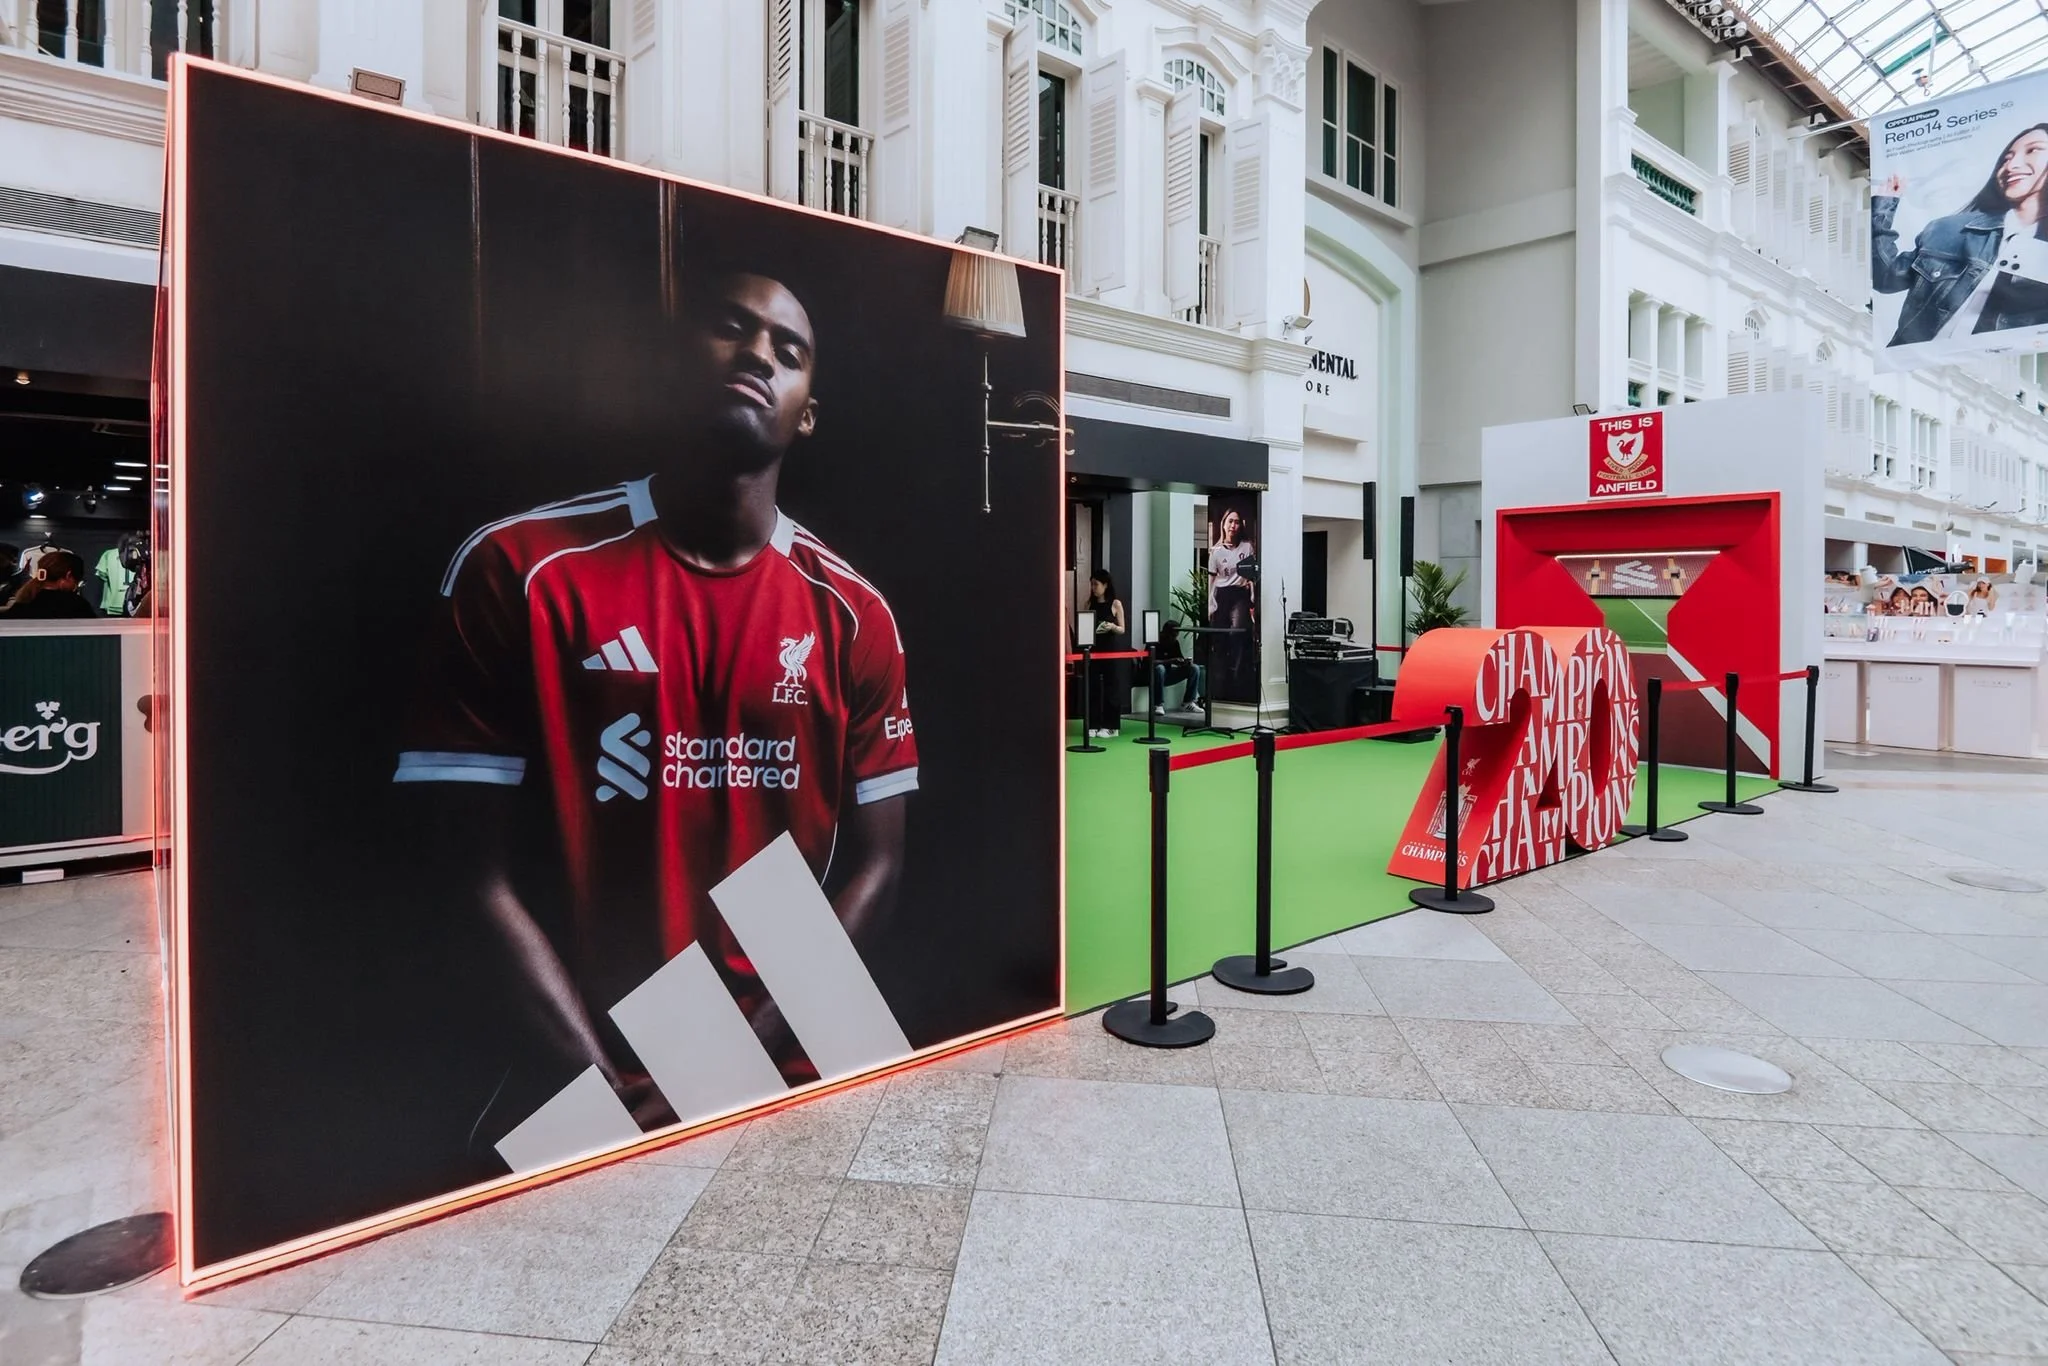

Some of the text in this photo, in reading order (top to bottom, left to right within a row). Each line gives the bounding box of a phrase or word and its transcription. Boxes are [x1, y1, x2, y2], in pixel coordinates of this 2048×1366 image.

[1885, 120, 1942, 145] Reno14
[1946, 107, 1998, 128] Series
[1887, 118, 1907, 128] OPPO
[1599, 417, 1653, 433] THIS IS
[1596, 480, 1657, 494] ANFIELD
[0, 717, 101, 774] erg
[664, 730, 796, 762] standard
[662, 760, 800, 790] chartered
[1401, 844, 1469, 867] CHAMPIS
